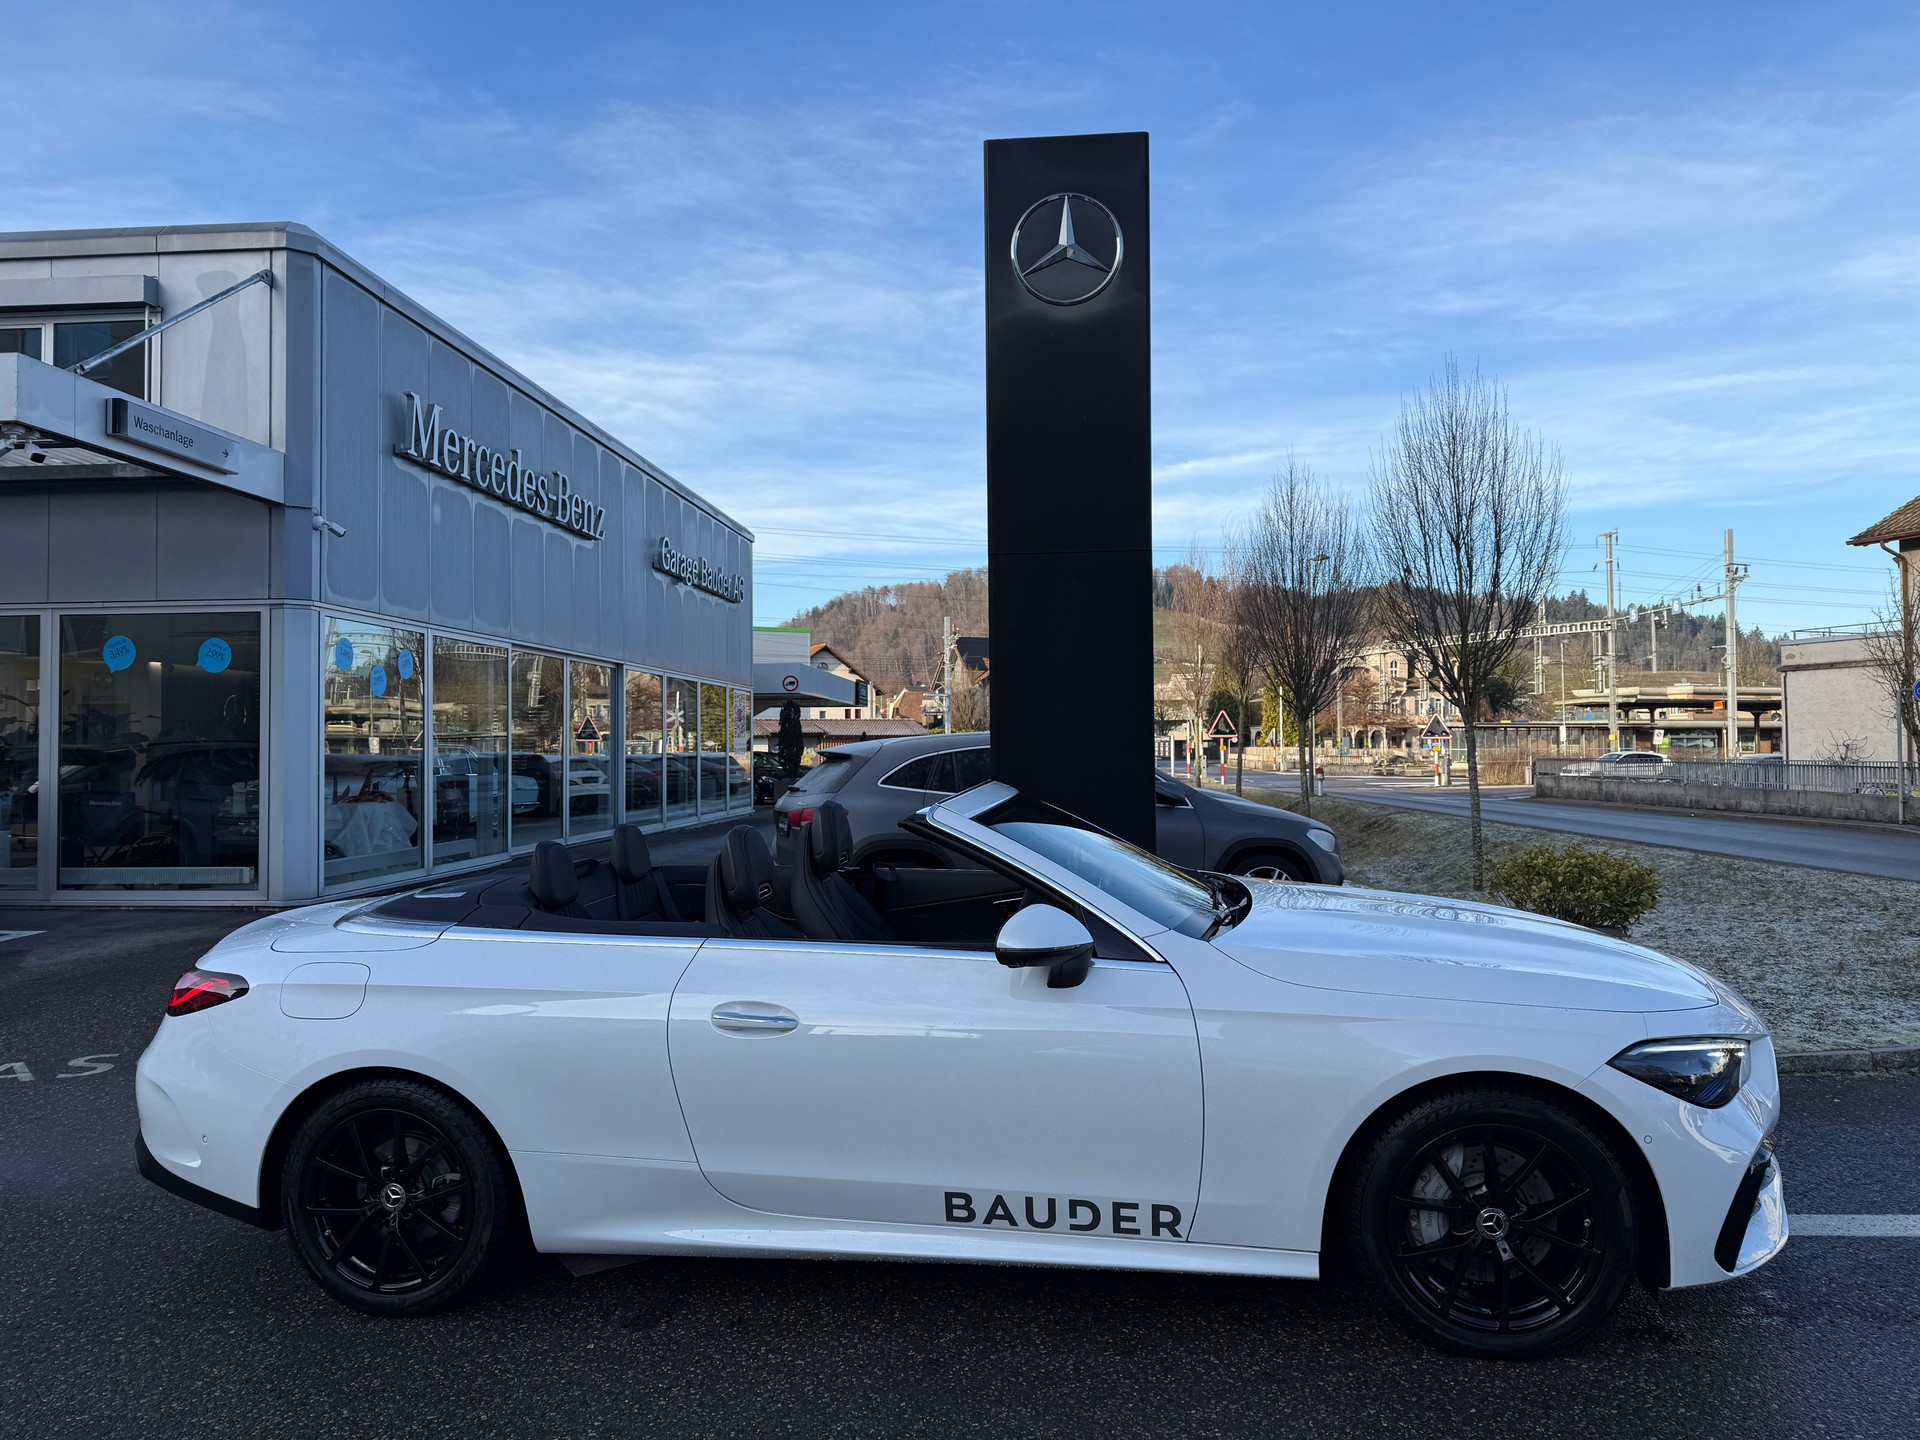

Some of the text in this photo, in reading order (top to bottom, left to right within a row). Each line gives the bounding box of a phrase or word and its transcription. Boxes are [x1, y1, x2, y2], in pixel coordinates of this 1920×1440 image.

[133, 415, 194, 448] Waschanlage
[403, 391, 606, 541] Mercedes-Benz
[660, 536, 744, 602] Garage Bauder AG
[944, 1191, 1183, 1239] BAUDER
